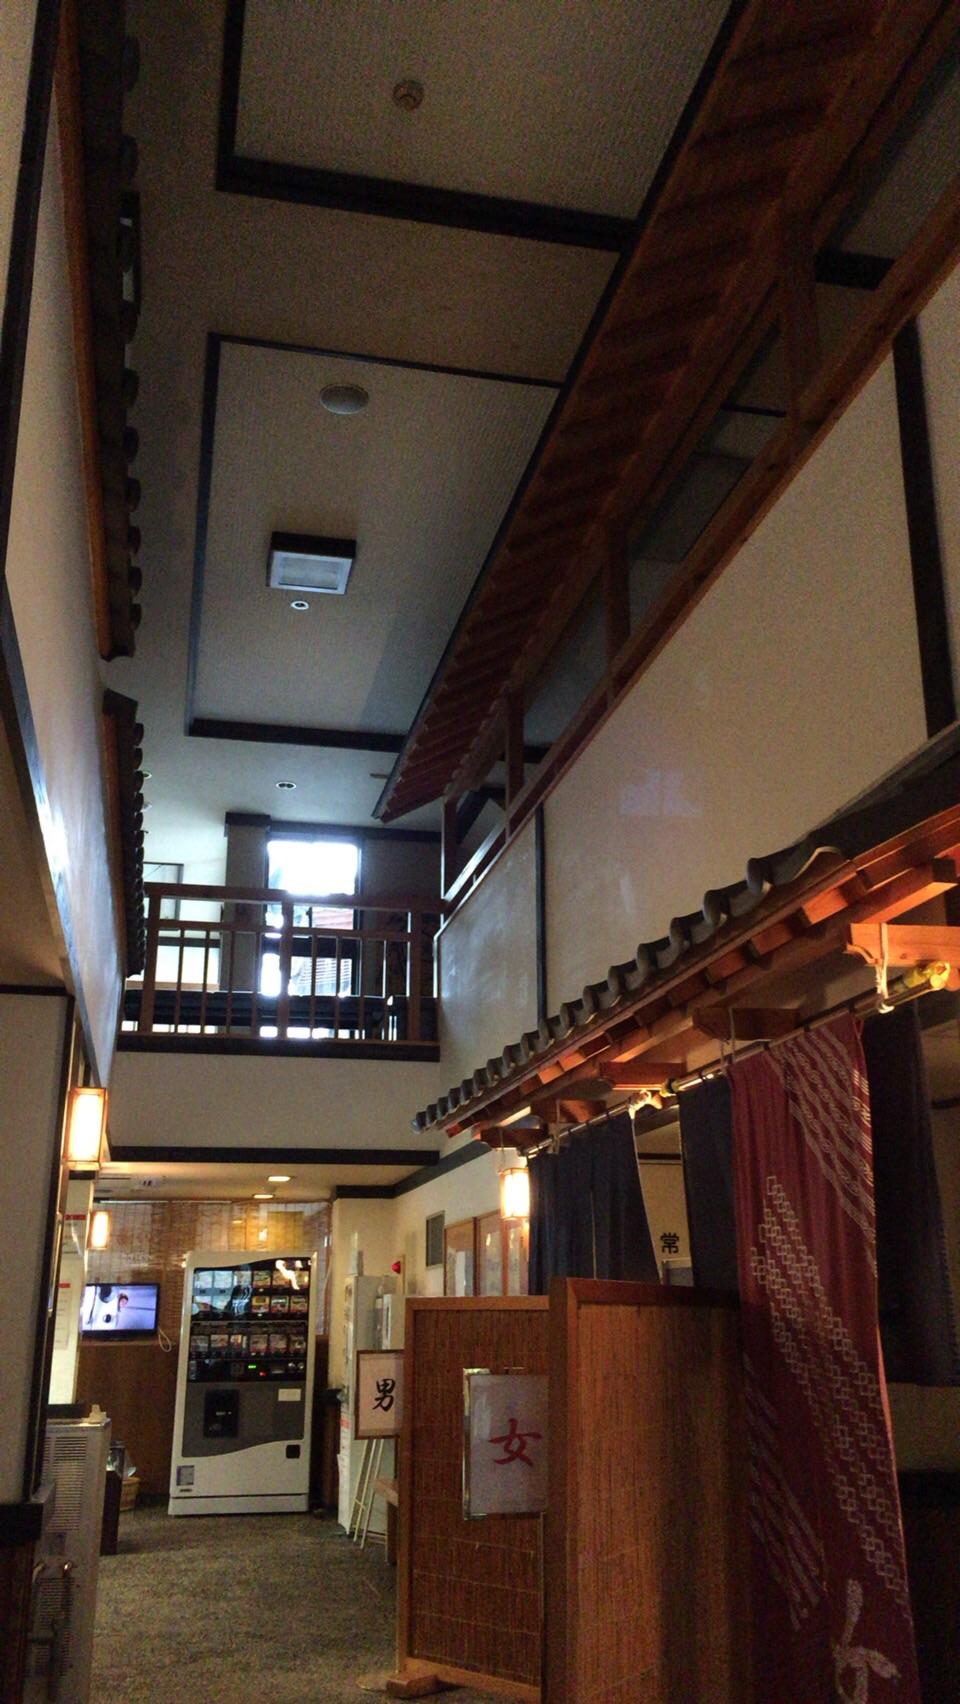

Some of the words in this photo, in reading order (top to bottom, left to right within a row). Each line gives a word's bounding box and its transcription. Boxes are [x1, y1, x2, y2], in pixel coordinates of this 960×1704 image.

[660, 1232, 680, 1255] 常
[372, 1378, 395, 1412] 男
[487, 1418, 543, 1467] 女
